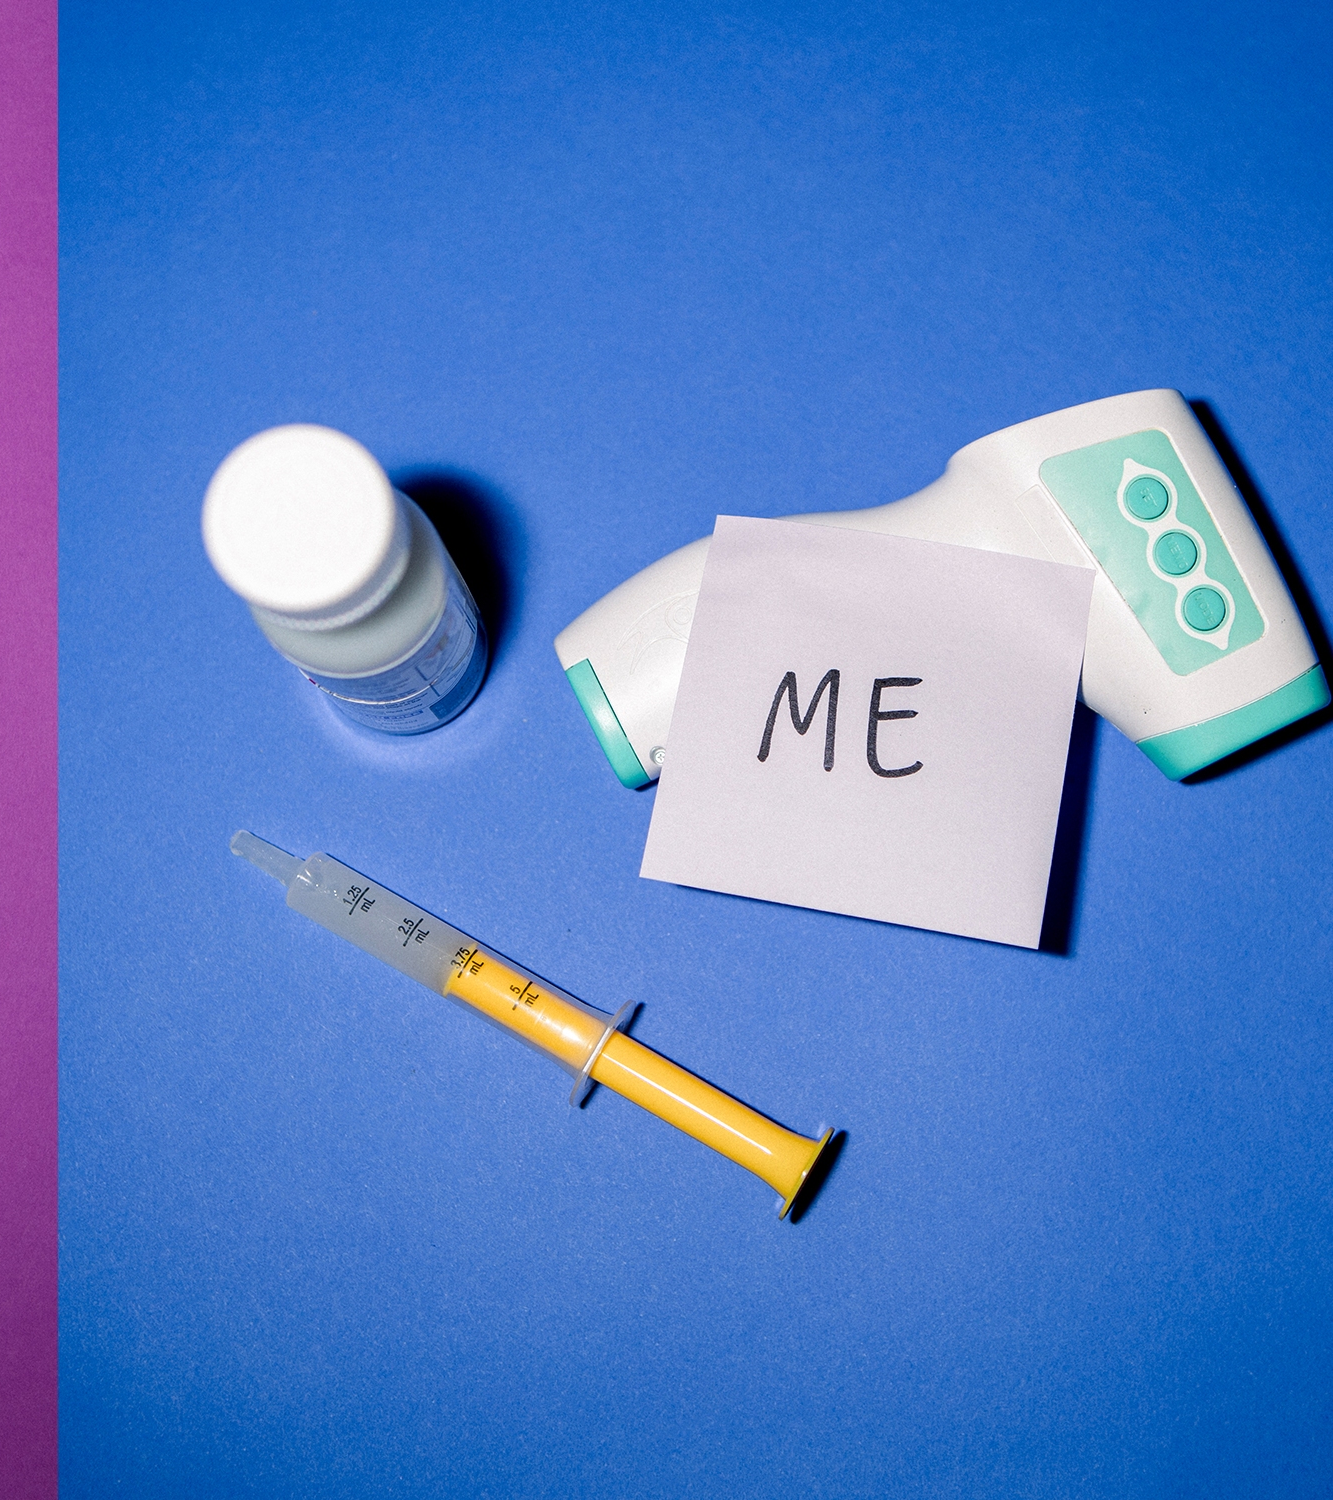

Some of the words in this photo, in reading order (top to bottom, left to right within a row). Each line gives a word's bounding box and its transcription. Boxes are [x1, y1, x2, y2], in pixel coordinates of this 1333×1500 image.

[757, 668, 924, 778] ME
[342, 885, 362, 906] 1.25
[360, 897, 376, 913] mL
[397, 917, 415, 935] 2.5
[414, 929, 430, 944] mL
[450, 947, 471, 969] 3.75
[468, 960, 484, 976] mL
[509, 984, 521, 995] 5
[523, 992, 540, 1008] mL
